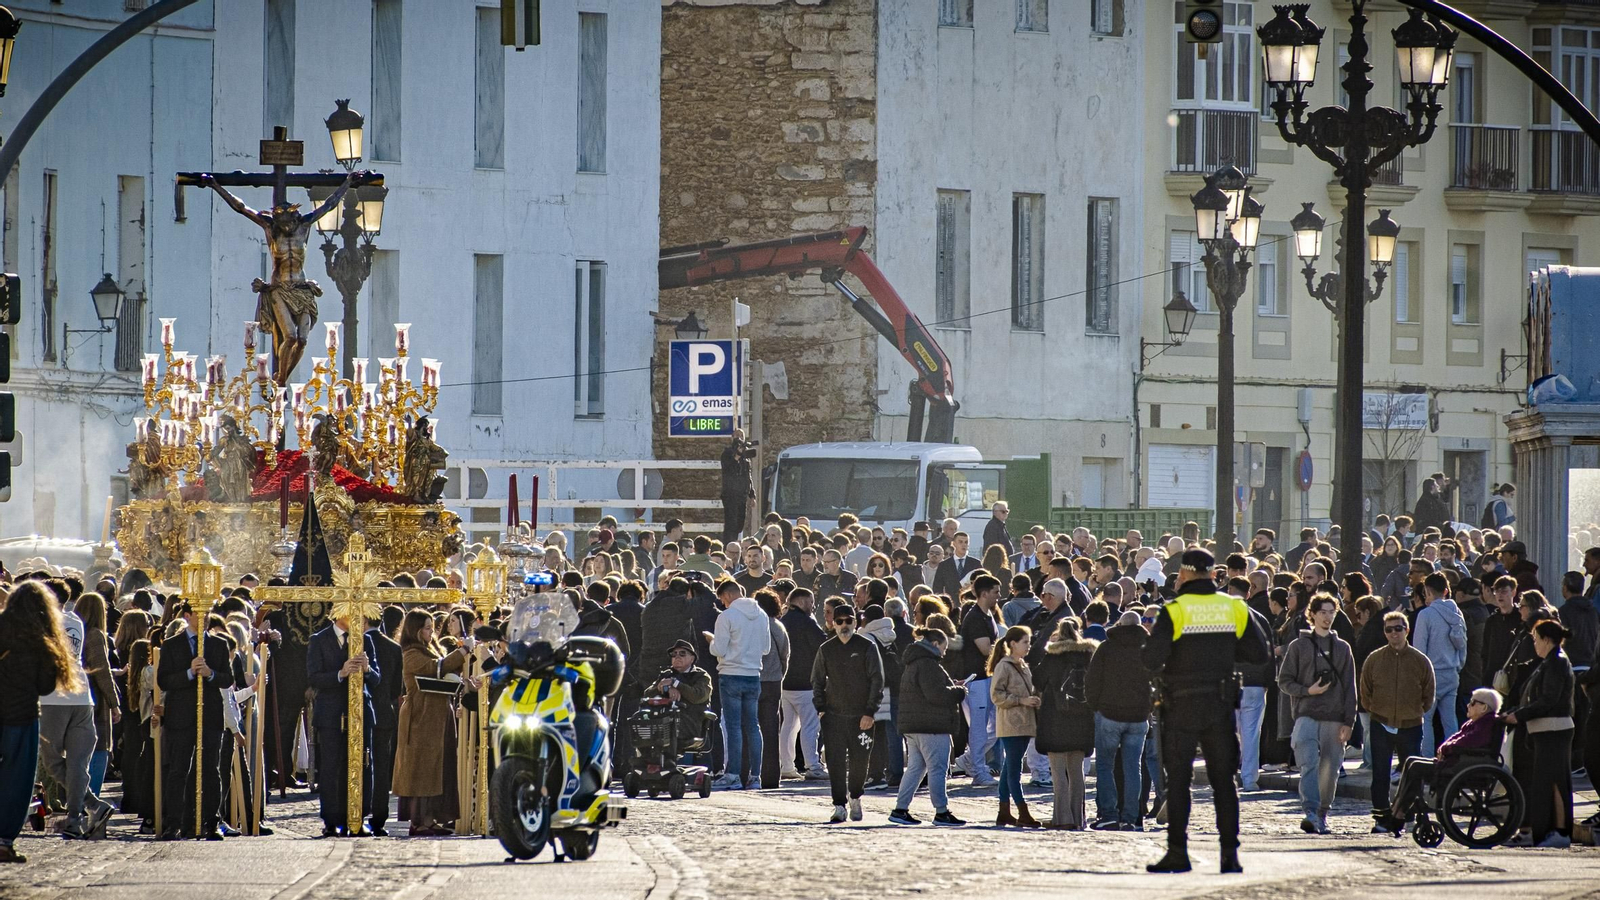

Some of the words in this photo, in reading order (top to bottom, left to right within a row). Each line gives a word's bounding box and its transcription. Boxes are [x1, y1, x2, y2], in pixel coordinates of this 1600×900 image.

[689, 343, 726, 394] P
[689, 418, 721, 430] LIBRE
[1100, 433, 1106, 448] 8
[347, 552, 368, 562] INRI
[1192, 613, 1227, 622] LOCAL
